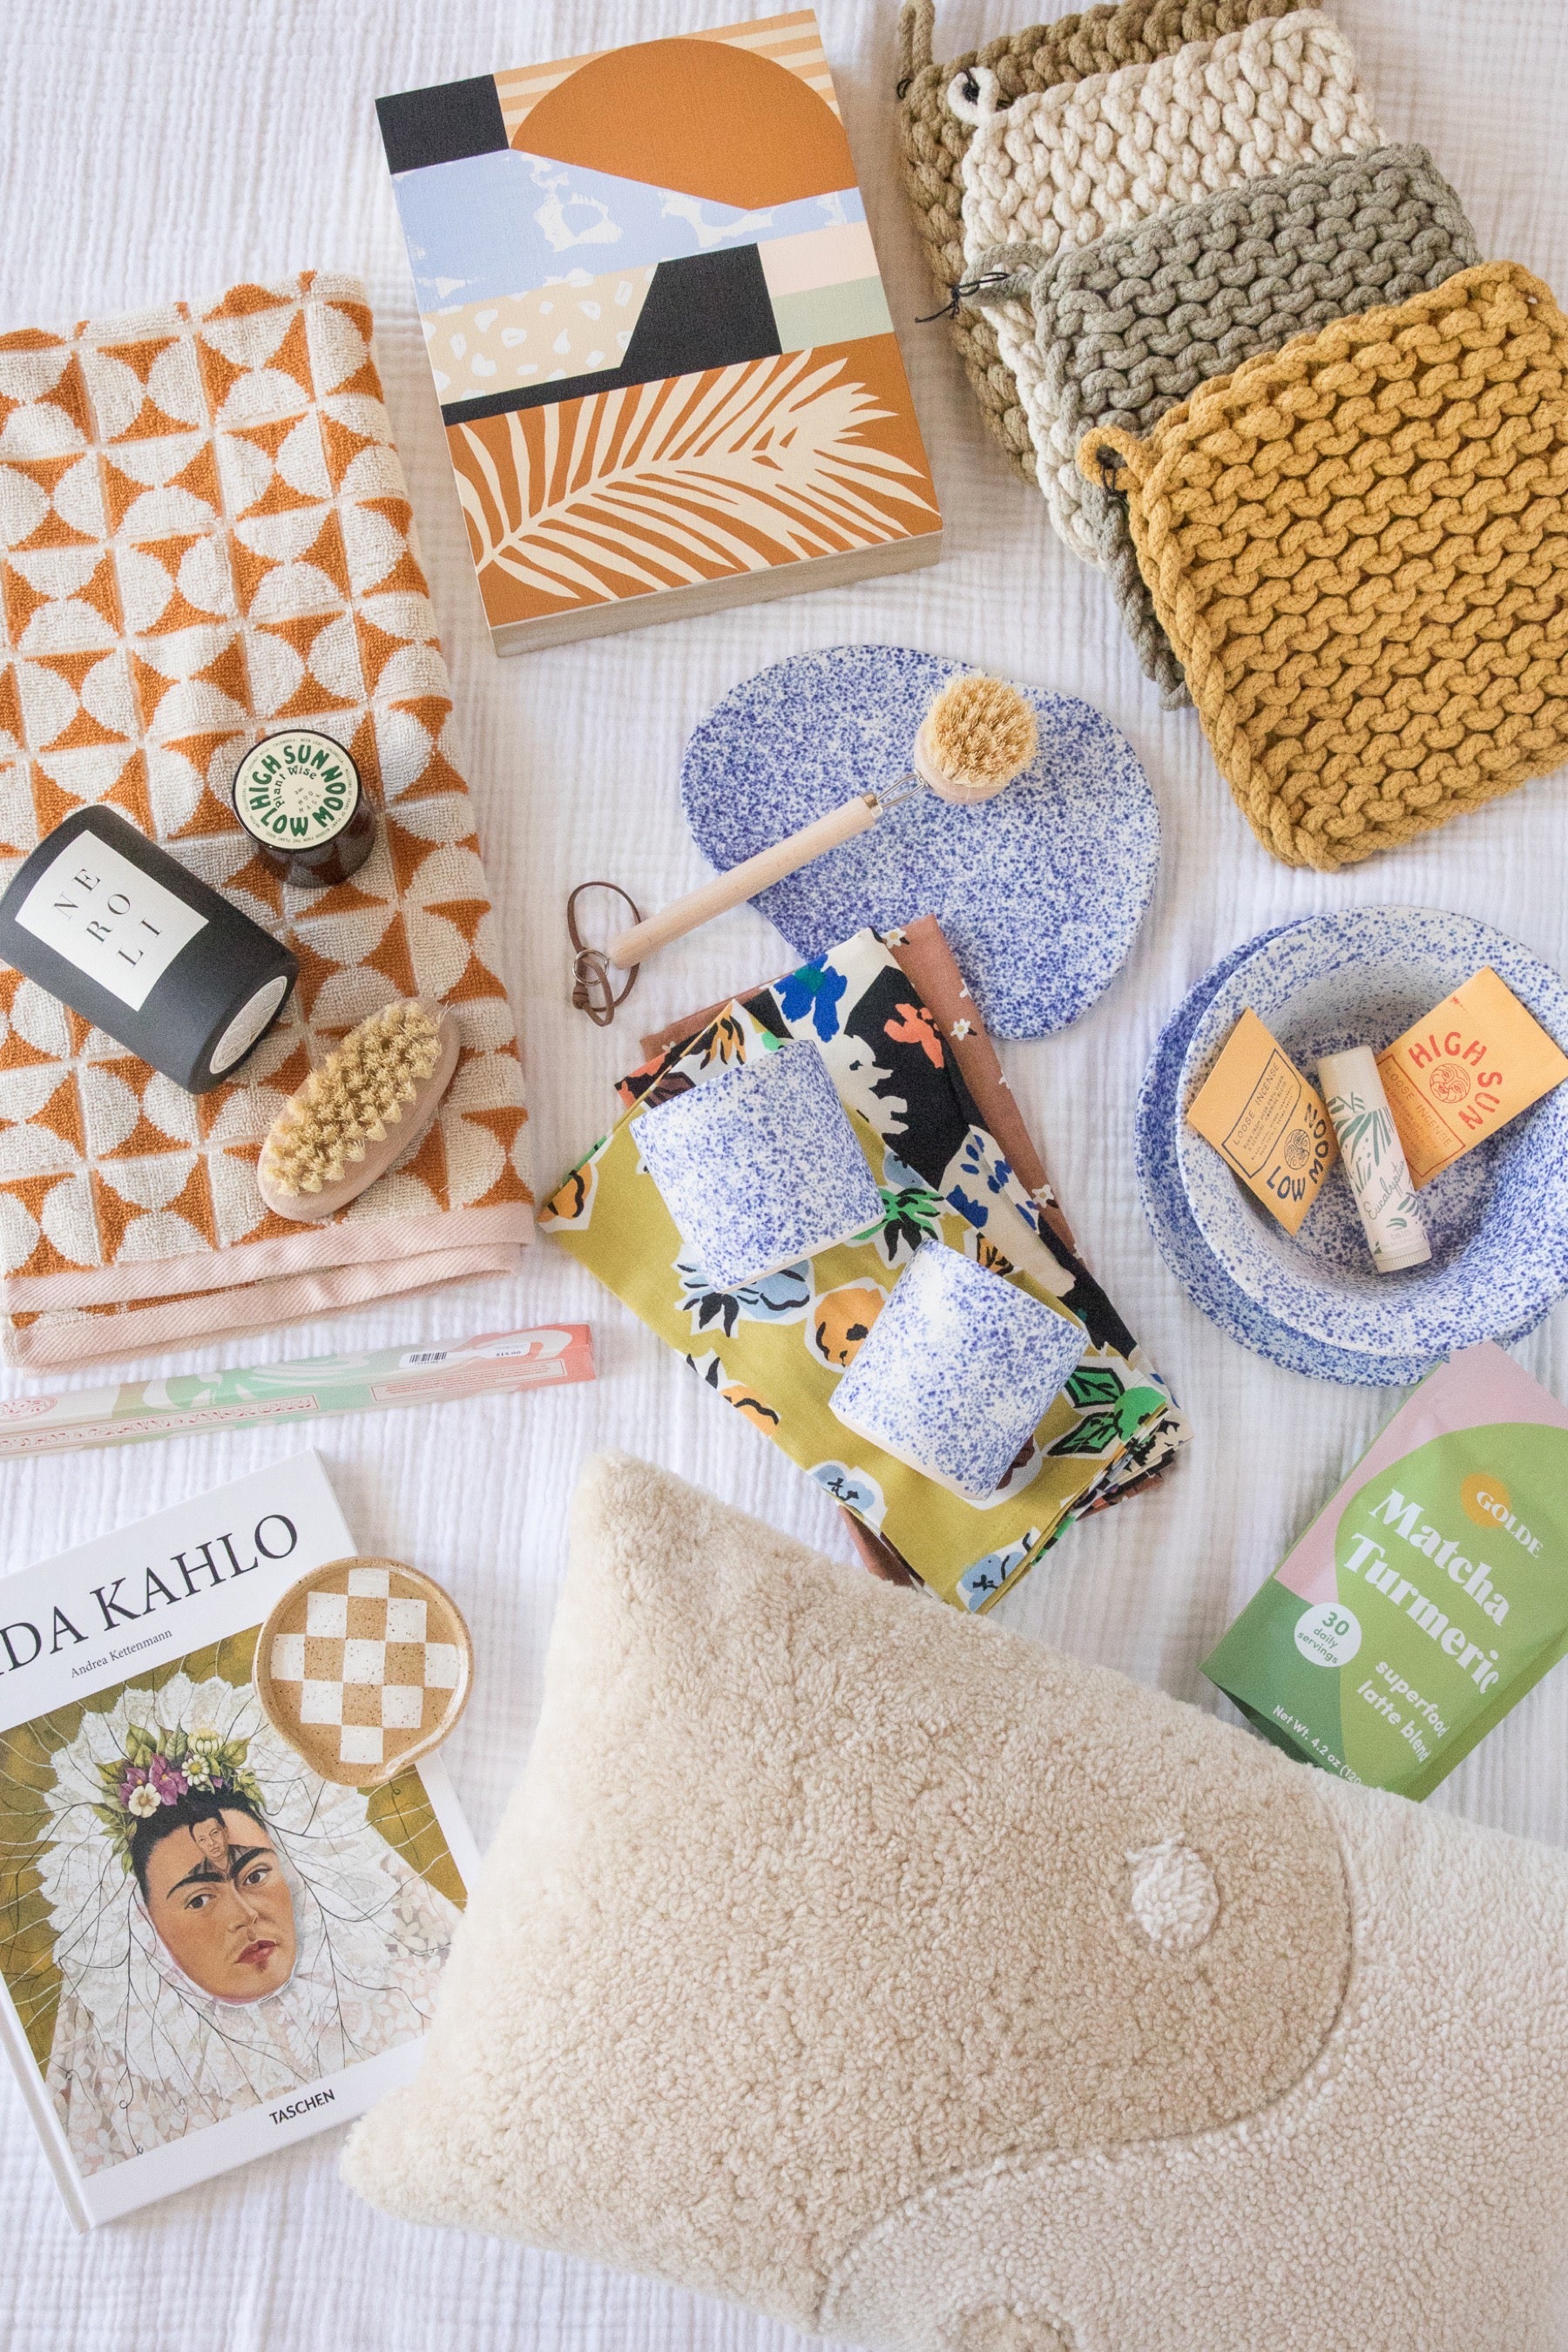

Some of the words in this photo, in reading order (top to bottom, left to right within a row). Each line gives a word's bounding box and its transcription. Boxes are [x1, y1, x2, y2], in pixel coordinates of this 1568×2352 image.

[248, 754, 282, 810] HIGH
[283, 744, 330, 770] SUN
[260, 808, 309, 837] LOW
[312, 766, 347, 828] MOON
[273, 773, 287, 809] Plant
[287, 765, 317, 781] Wise
[53, 868, 100, 920] NE
[85, 894, 131, 943] RO
[118, 918, 162, 968] LI
[1232, 1110, 1256, 1146] LOOSE
[1254, 1062, 1280, 1106] INCENSE
[1384, 1065, 1416, 1100] LOOSE
[1415, 1103, 1454, 1147] INCENSE
[1408, 1031, 1488, 1069] HIGH
[1458, 1071, 1503, 1131] SUN
[1266, 1165, 1307, 1202] LOW
[1476, 1490, 1544, 1558] GOLDE
[1368, 1488, 1512, 1626] Matcha
[0, 1622, 89, 1675] DA
[90, 1514, 298, 1632] KAHLO
[1321, 1611, 1350, 1638] 30
[1342, 1532, 1501, 1694] Turmeric
[71, 1655, 109, 1679] Andrea
[108, 1628, 173, 1662] Kettenmann
[1296, 1631, 1339, 1666] servings
[1313, 1625, 1339, 1651] daily
[1356, 1680, 1402, 1727] latte
[1401, 1720, 1431, 1763] blend
[1375, 1659, 1450, 1740] superfood
[1272, 1704, 1294, 1725] Net
[1293, 1719, 1309, 1740] Wt.
[1311, 1738, 1329, 1756] 4.2
[1327, 1754, 1342, 1768] oz
[268, 2088, 336, 2126] TASCHEN
